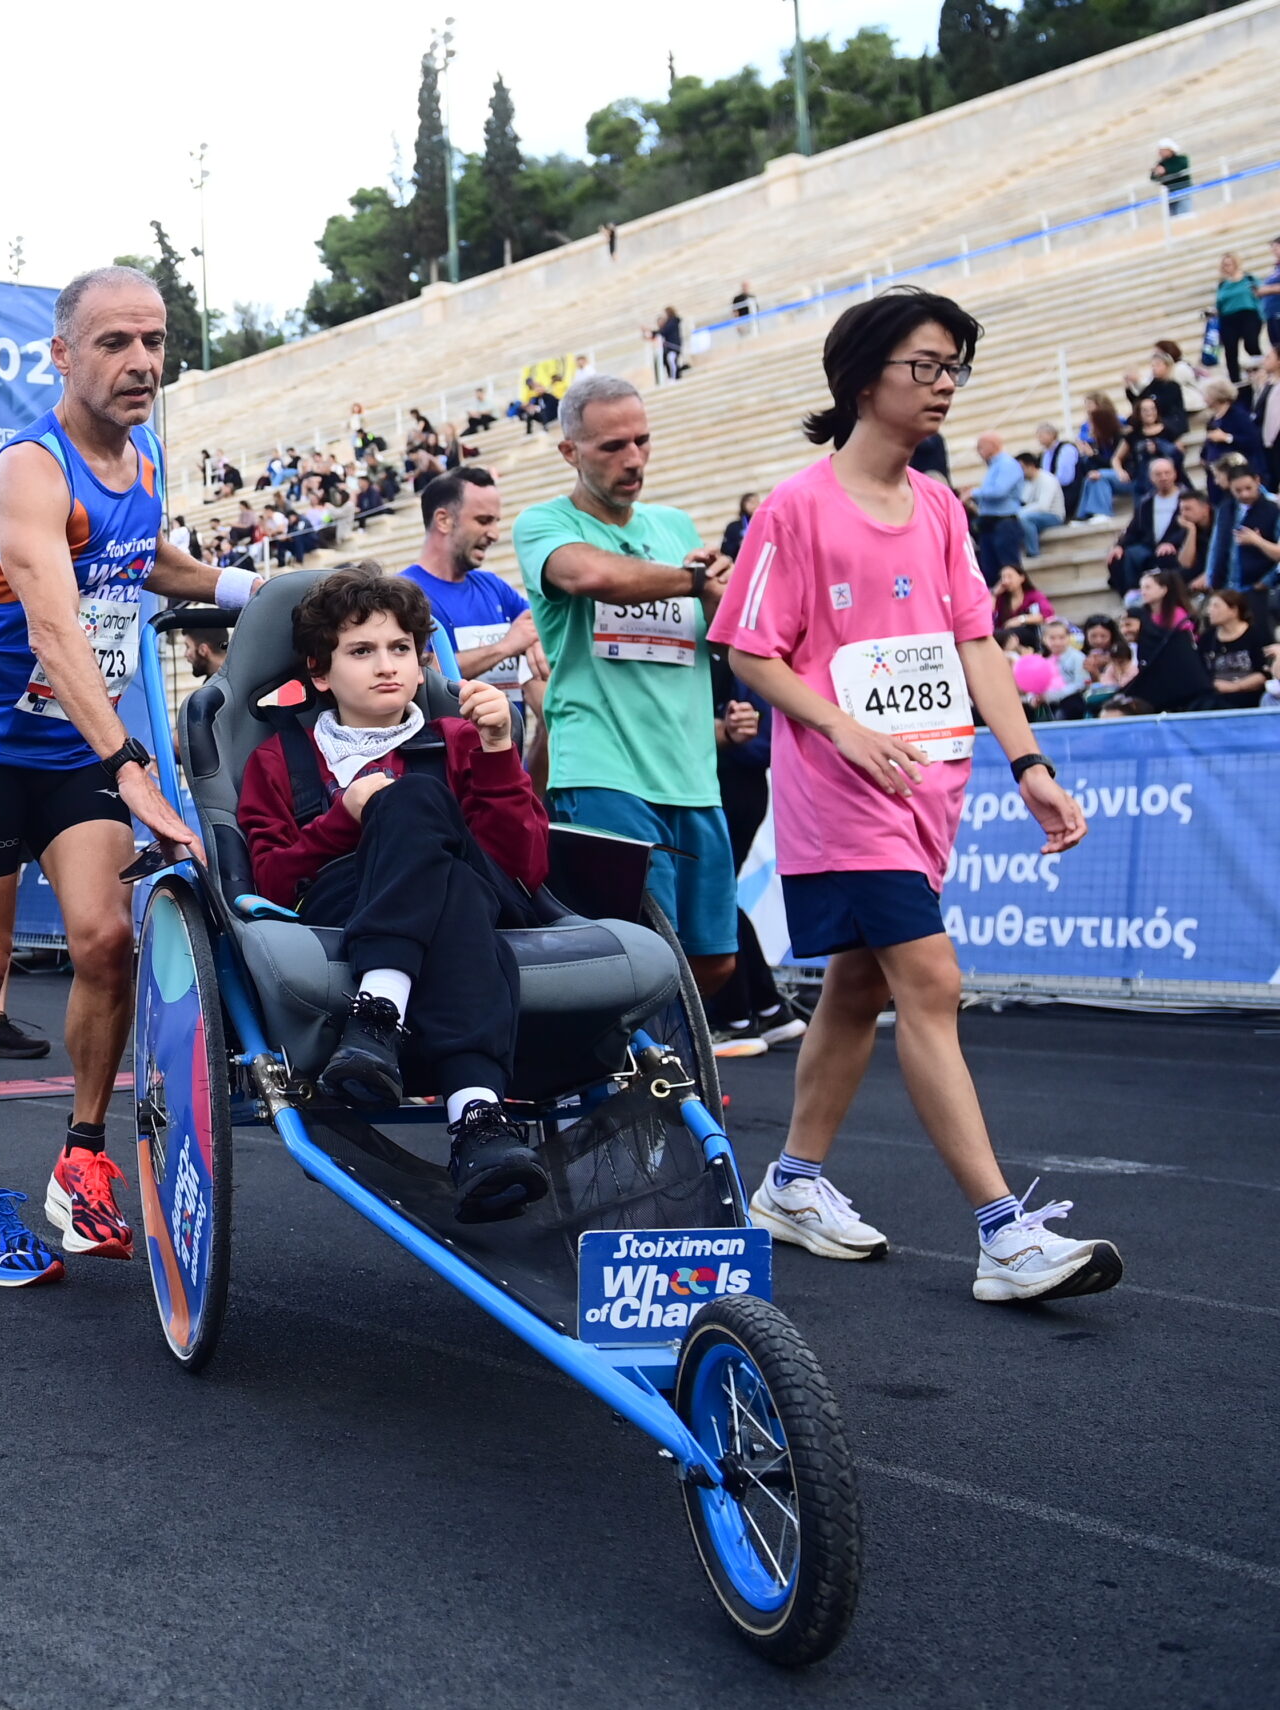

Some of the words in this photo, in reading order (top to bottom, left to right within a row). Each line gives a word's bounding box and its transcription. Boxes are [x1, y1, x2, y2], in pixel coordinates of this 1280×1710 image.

[93, 648, 127, 678] 723
[919, 663, 945, 672] allwyn
[865, 680, 952, 715] 44283
[612, 1233, 745, 1259] Stoiximan
[585, 1303, 611, 1322] of
